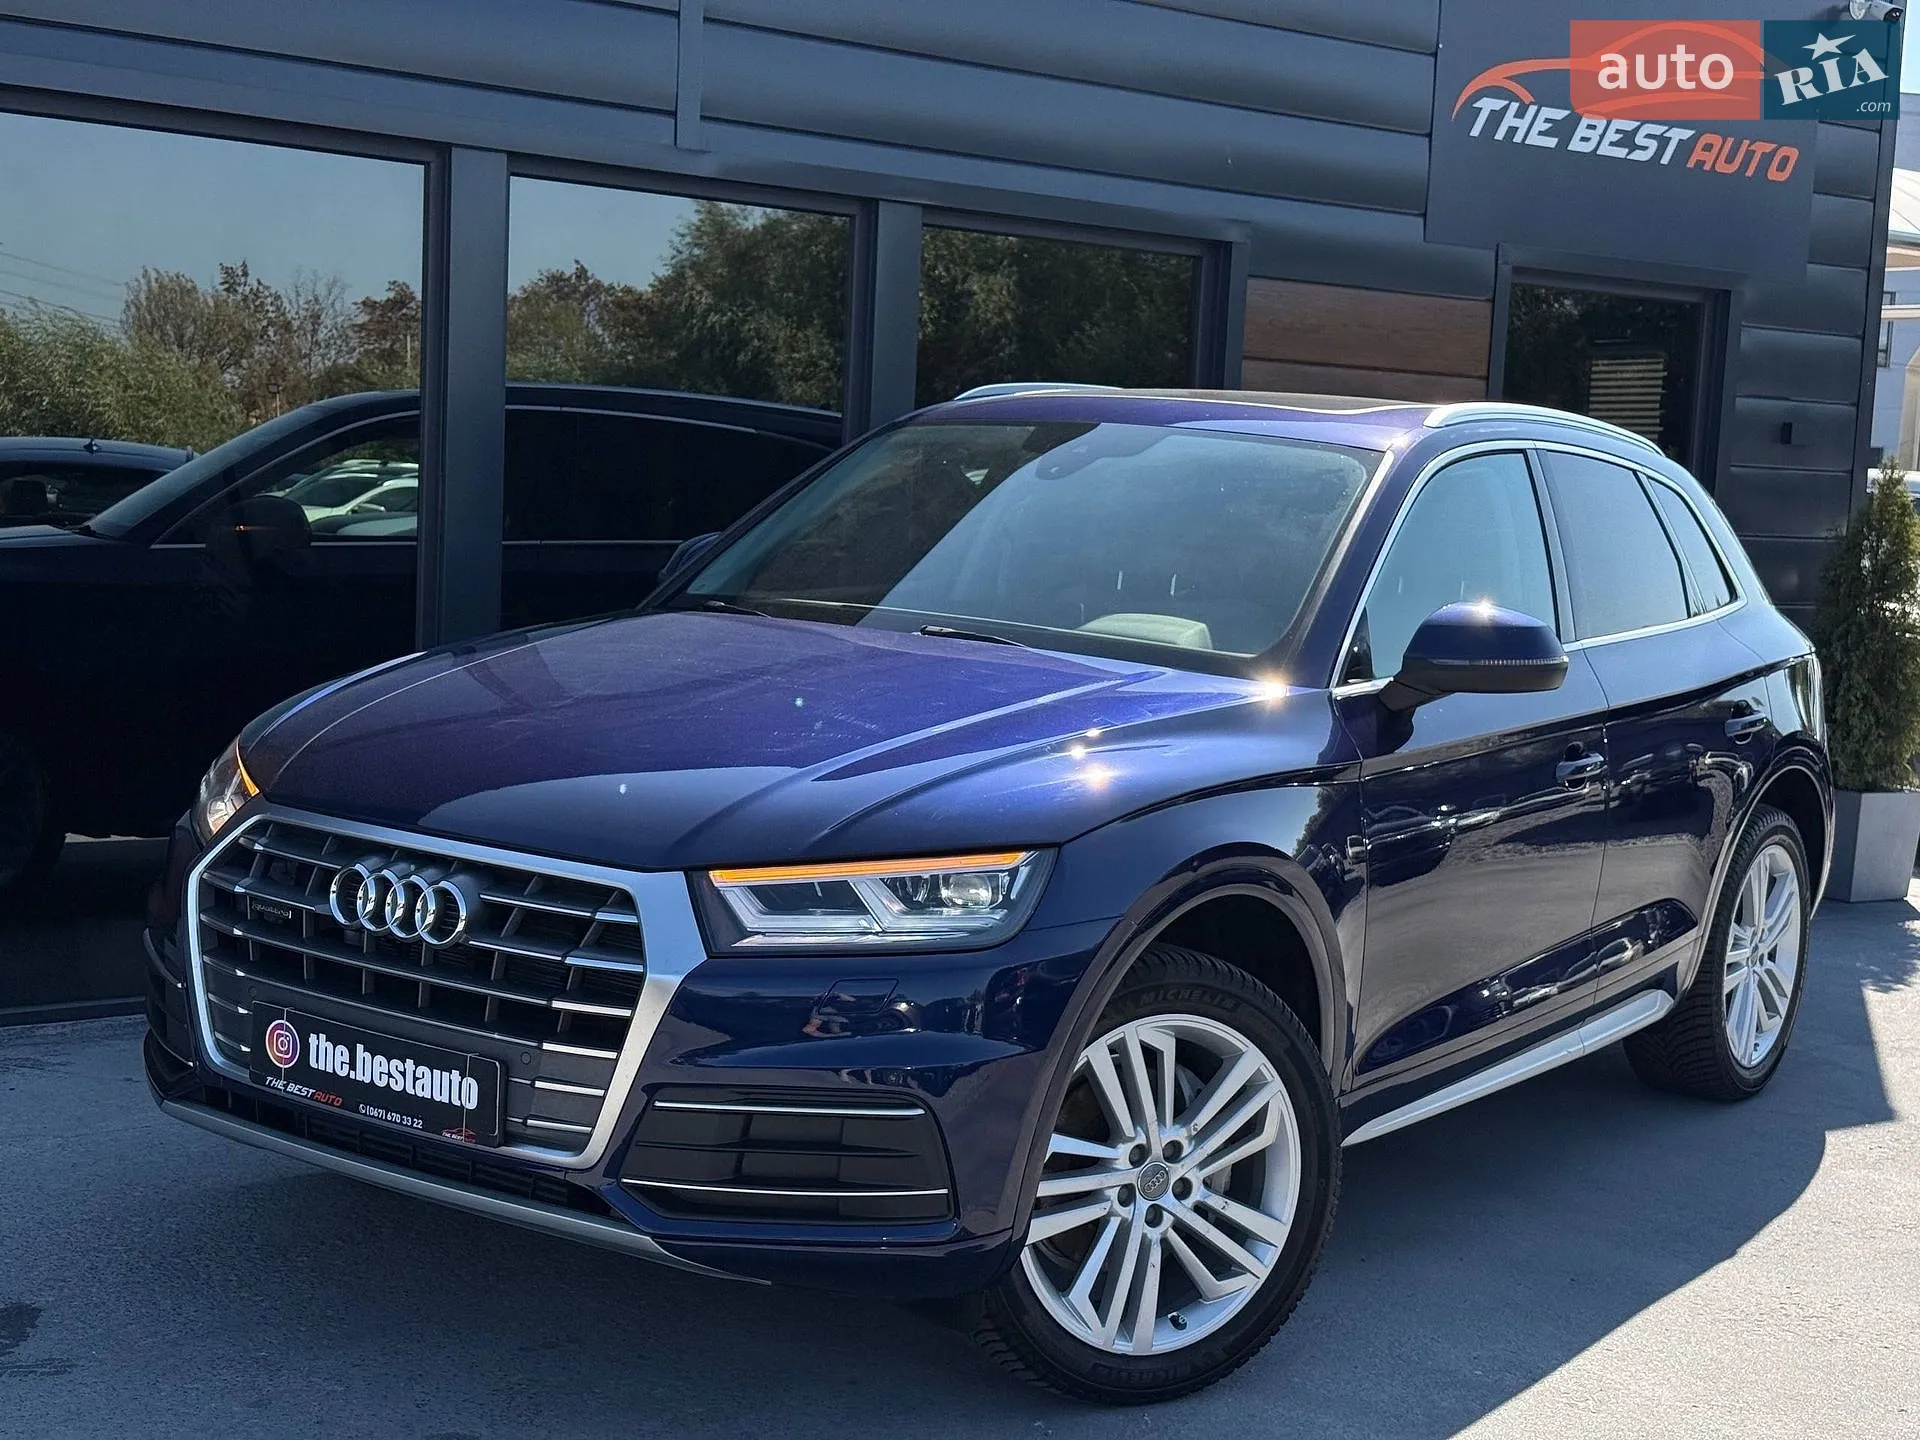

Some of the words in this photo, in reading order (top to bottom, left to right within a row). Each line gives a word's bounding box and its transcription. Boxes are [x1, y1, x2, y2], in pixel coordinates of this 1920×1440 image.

[1468, 97, 1570, 151] THE
[1567, 113, 1695, 165] BEST
[1686, 133, 1799, 183] AUTO
[265, 1076, 287, 1090] THE
[286, 1083, 316, 1098] BEST
[313, 1091, 343, 1106] AUTO
[308, 1033, 479, 1110] the.bestauto
[386, 1111, 401, 1123] 670
[402, 1115, 412, 1126] 33
[412, 1118, 423, 1129] 22
